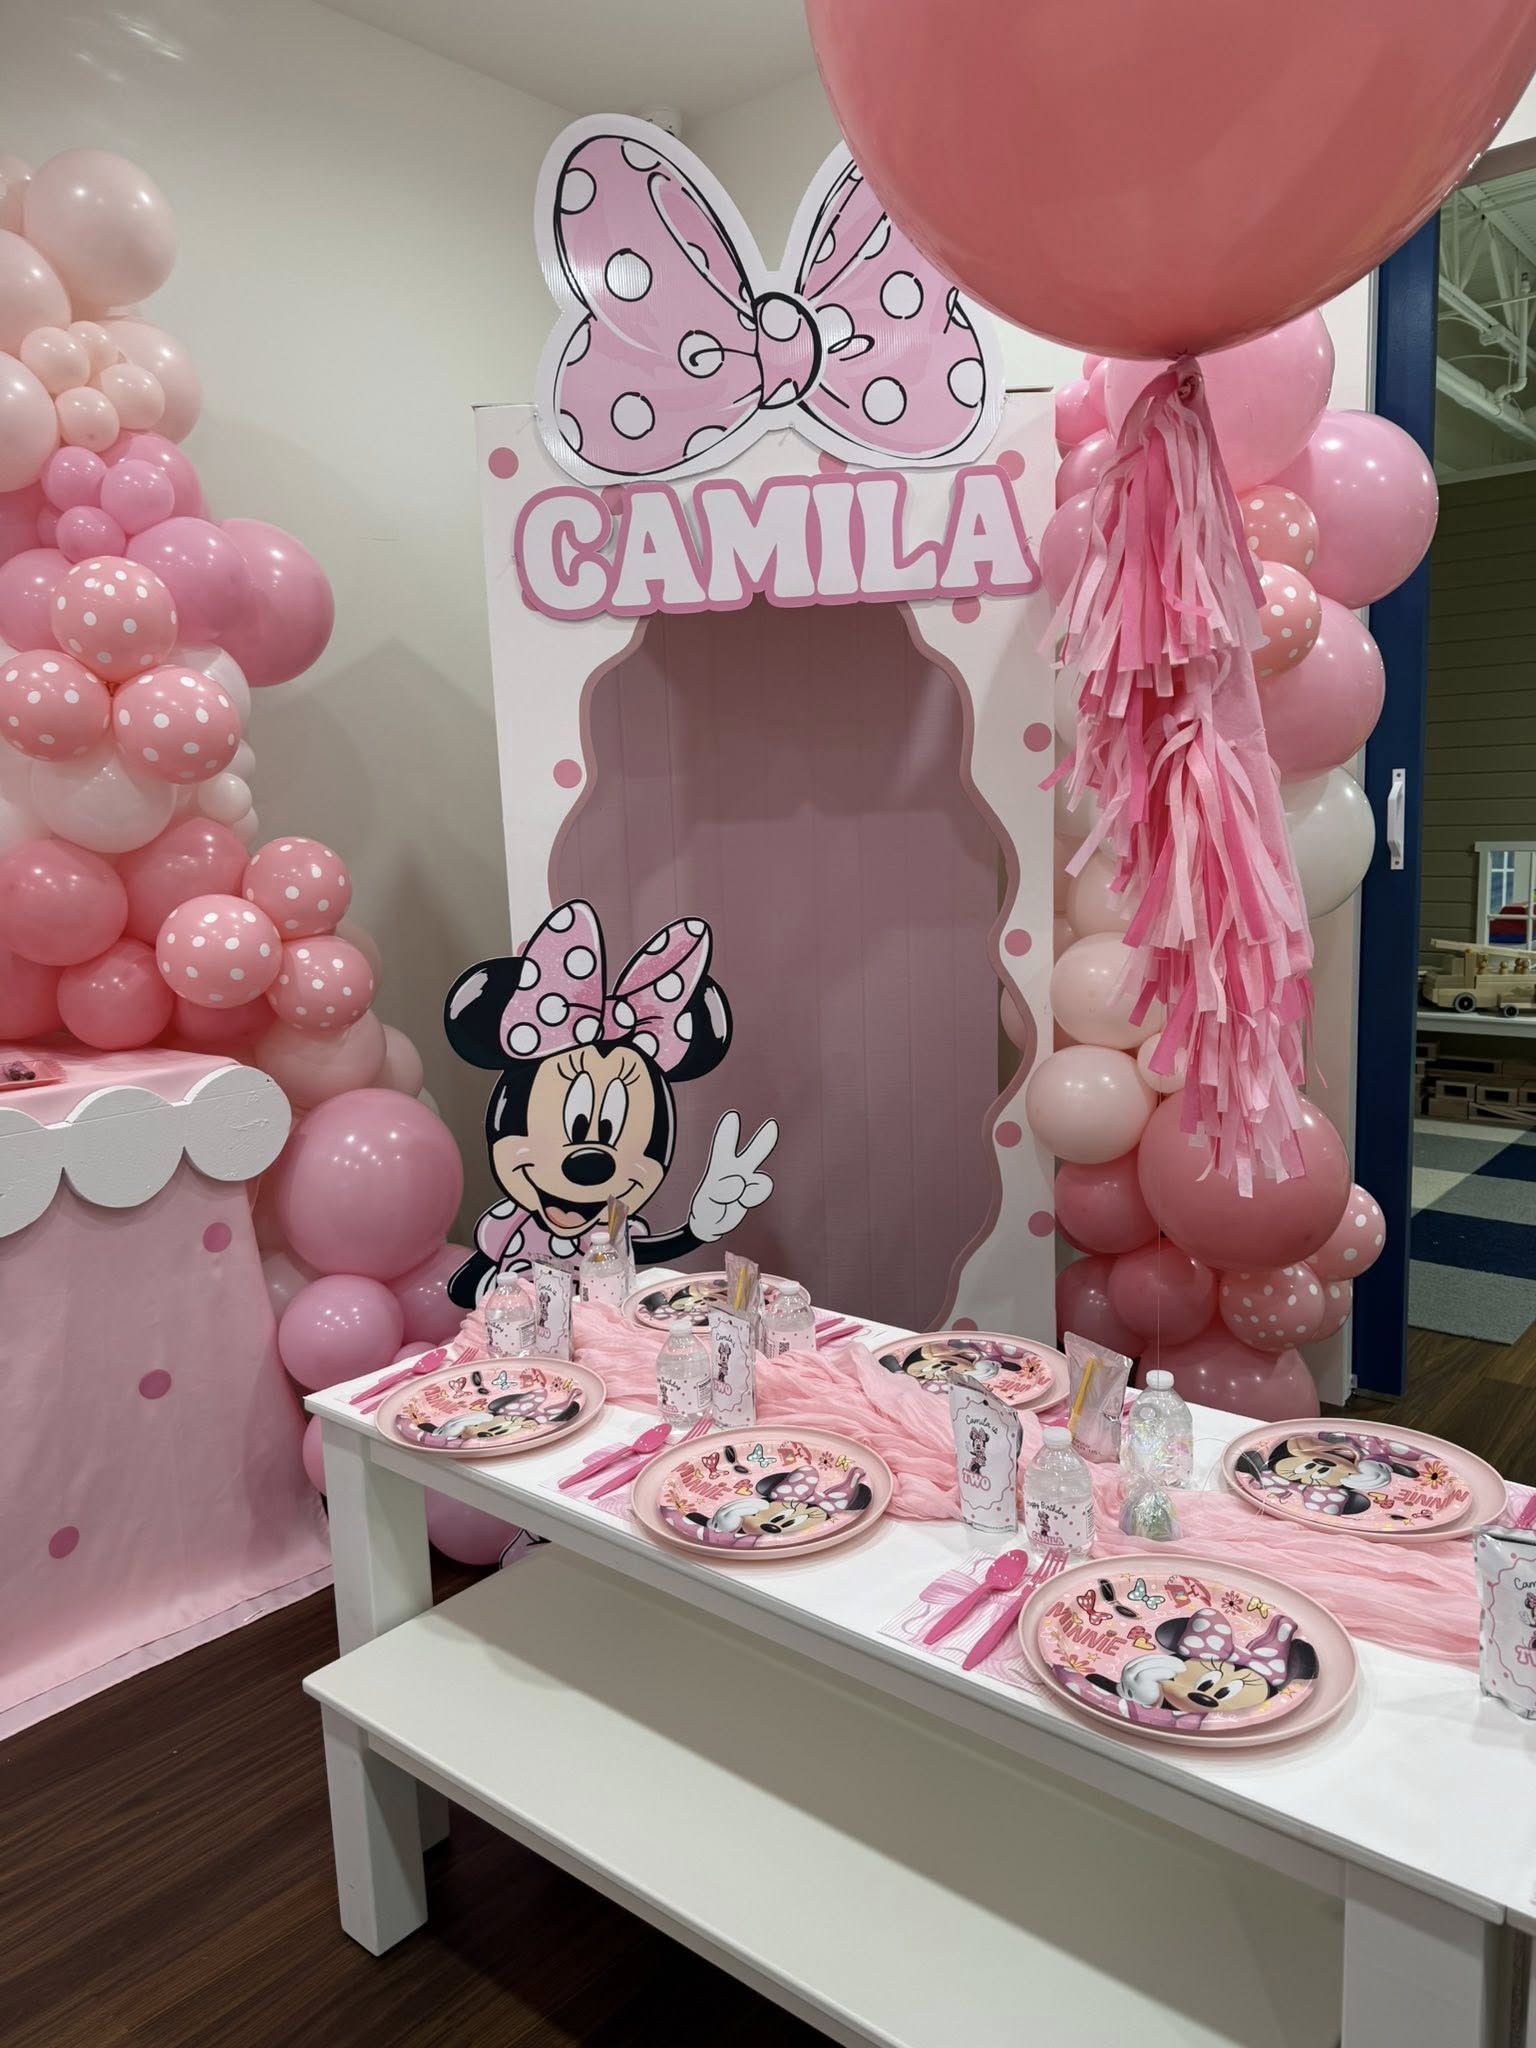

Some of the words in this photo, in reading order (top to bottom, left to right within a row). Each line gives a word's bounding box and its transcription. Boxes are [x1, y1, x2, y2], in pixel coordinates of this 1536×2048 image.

[515, 465, 1040, 619] CAMILA
[965, 1414, 991, 1429] Camila
[962, 1467, 991, 1492] TWO
[1040, 1500, 1069, 1519] Birthday
[1045, 1601, 1128, 1657] MINNIE
